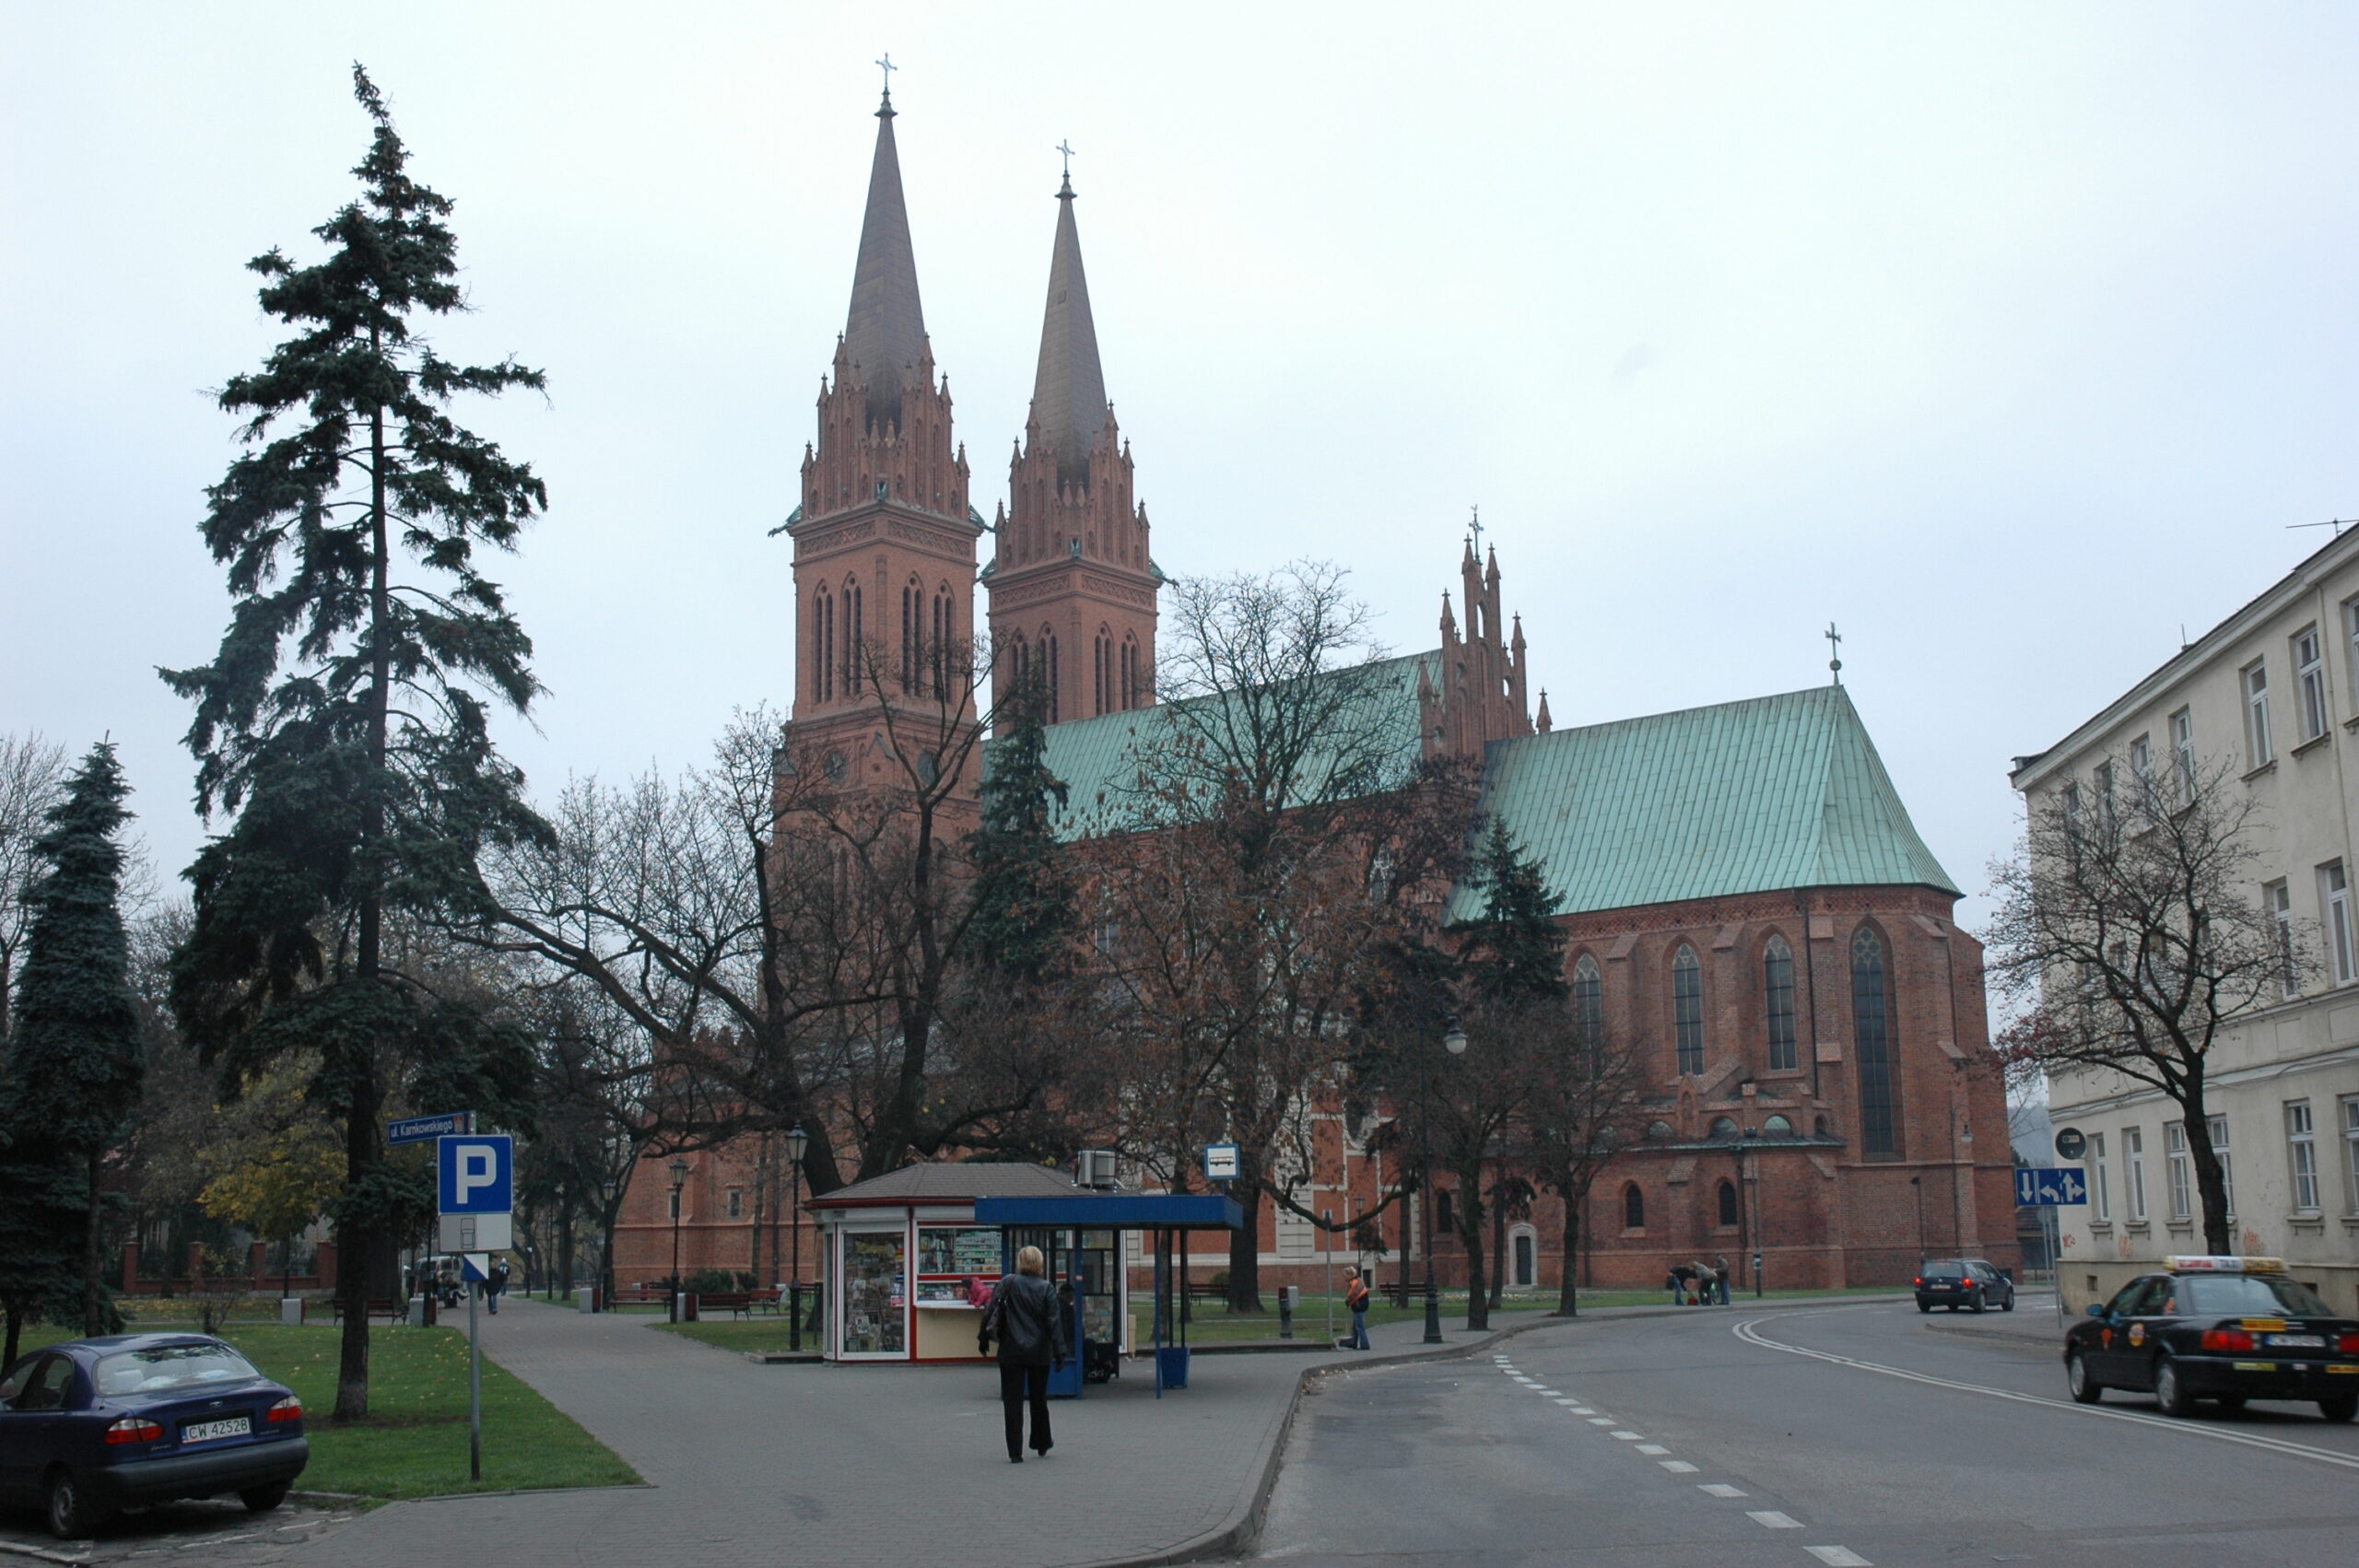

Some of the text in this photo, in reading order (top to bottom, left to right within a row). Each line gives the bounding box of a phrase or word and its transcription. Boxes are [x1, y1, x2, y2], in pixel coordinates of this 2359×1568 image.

[456, 1145, 497, 1204] P
[189, 1420, 248, 1439] CW 42528
